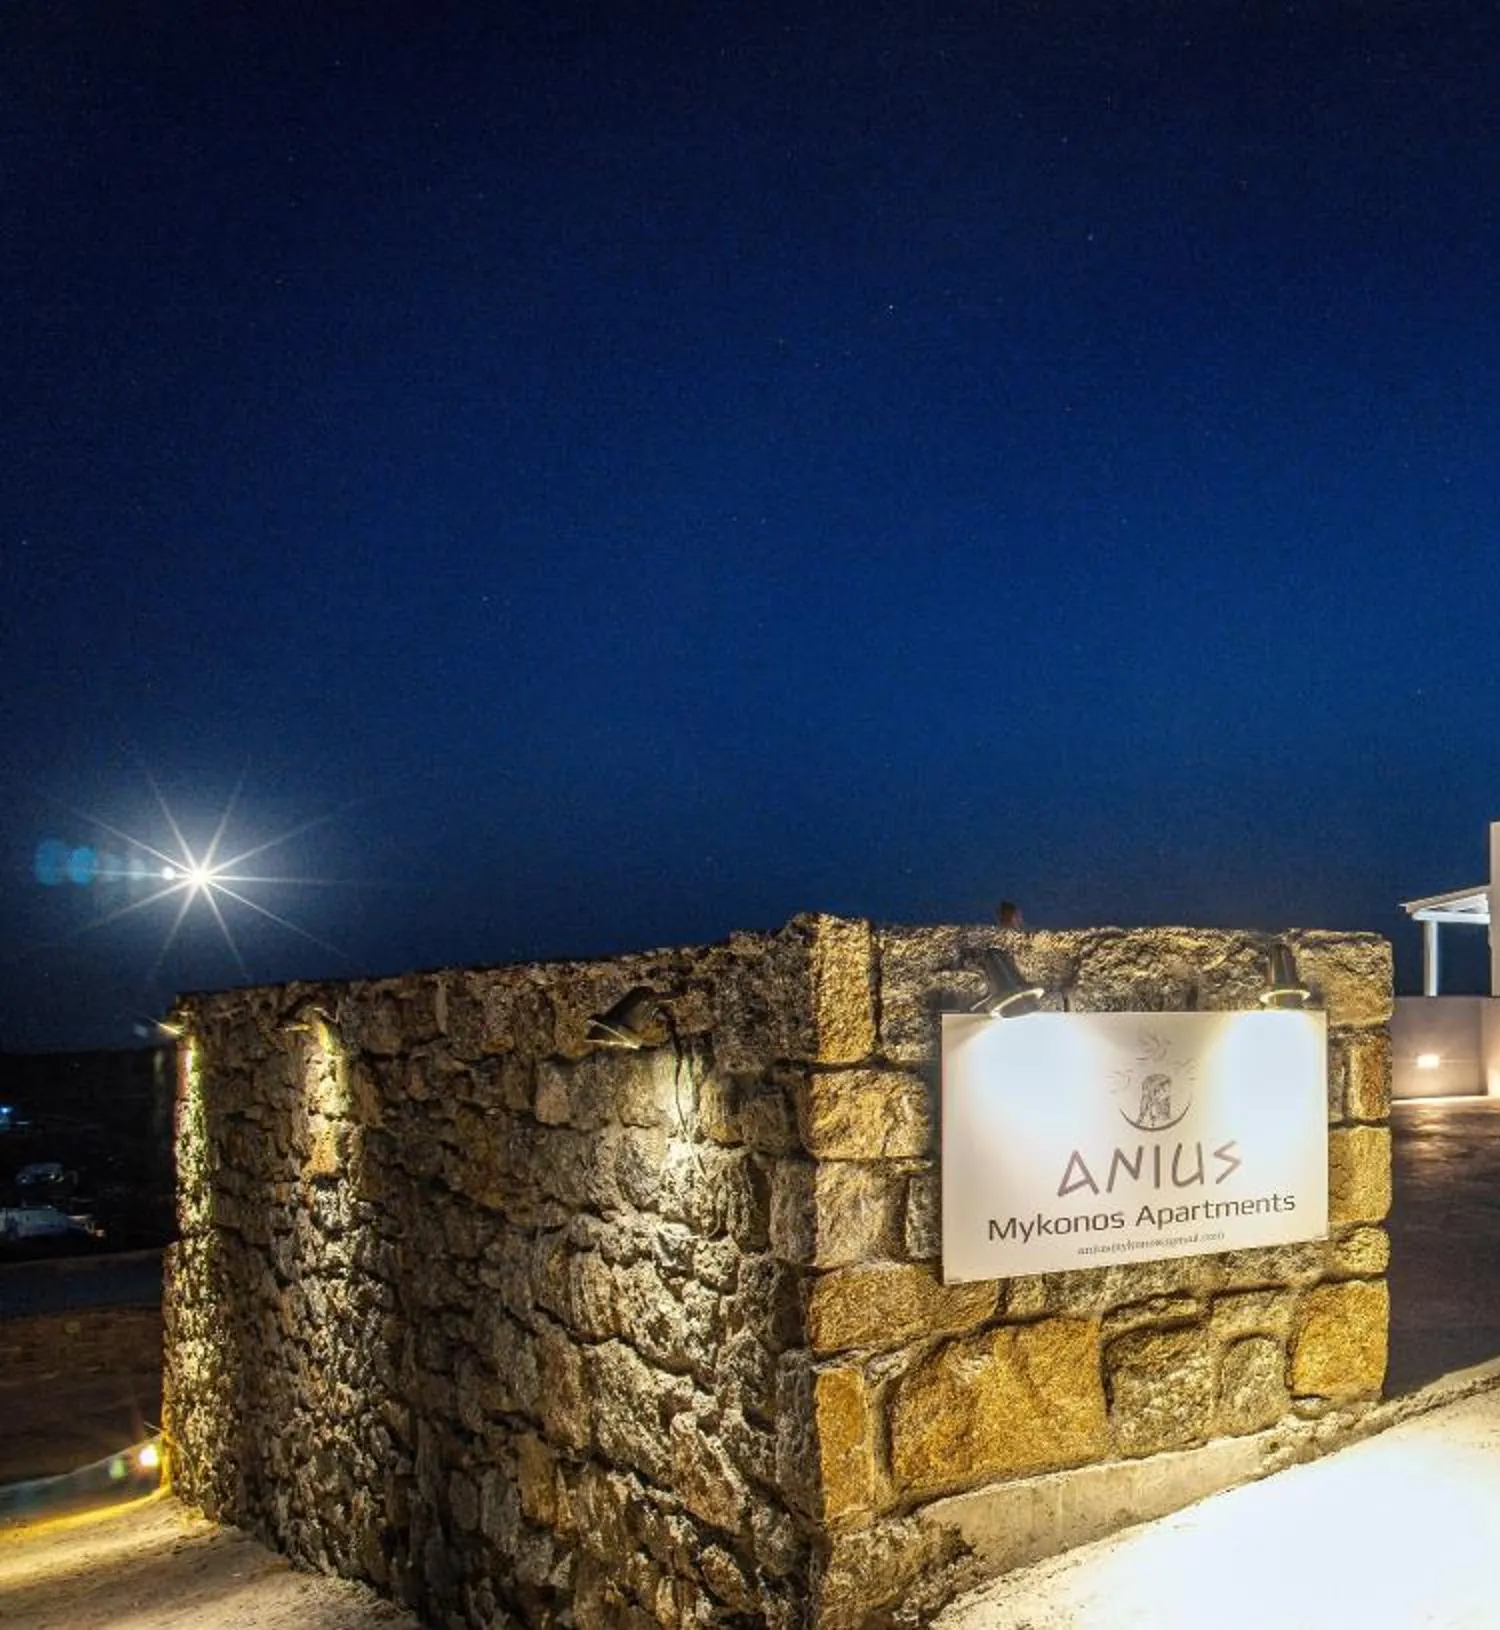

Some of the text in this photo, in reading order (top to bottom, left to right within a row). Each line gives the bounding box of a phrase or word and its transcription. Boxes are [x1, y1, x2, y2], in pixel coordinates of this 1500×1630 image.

[1058, 1140, 1243, 1197] ANIUS
[988, 1193, 1296, 1243] Mykonos Apartments
